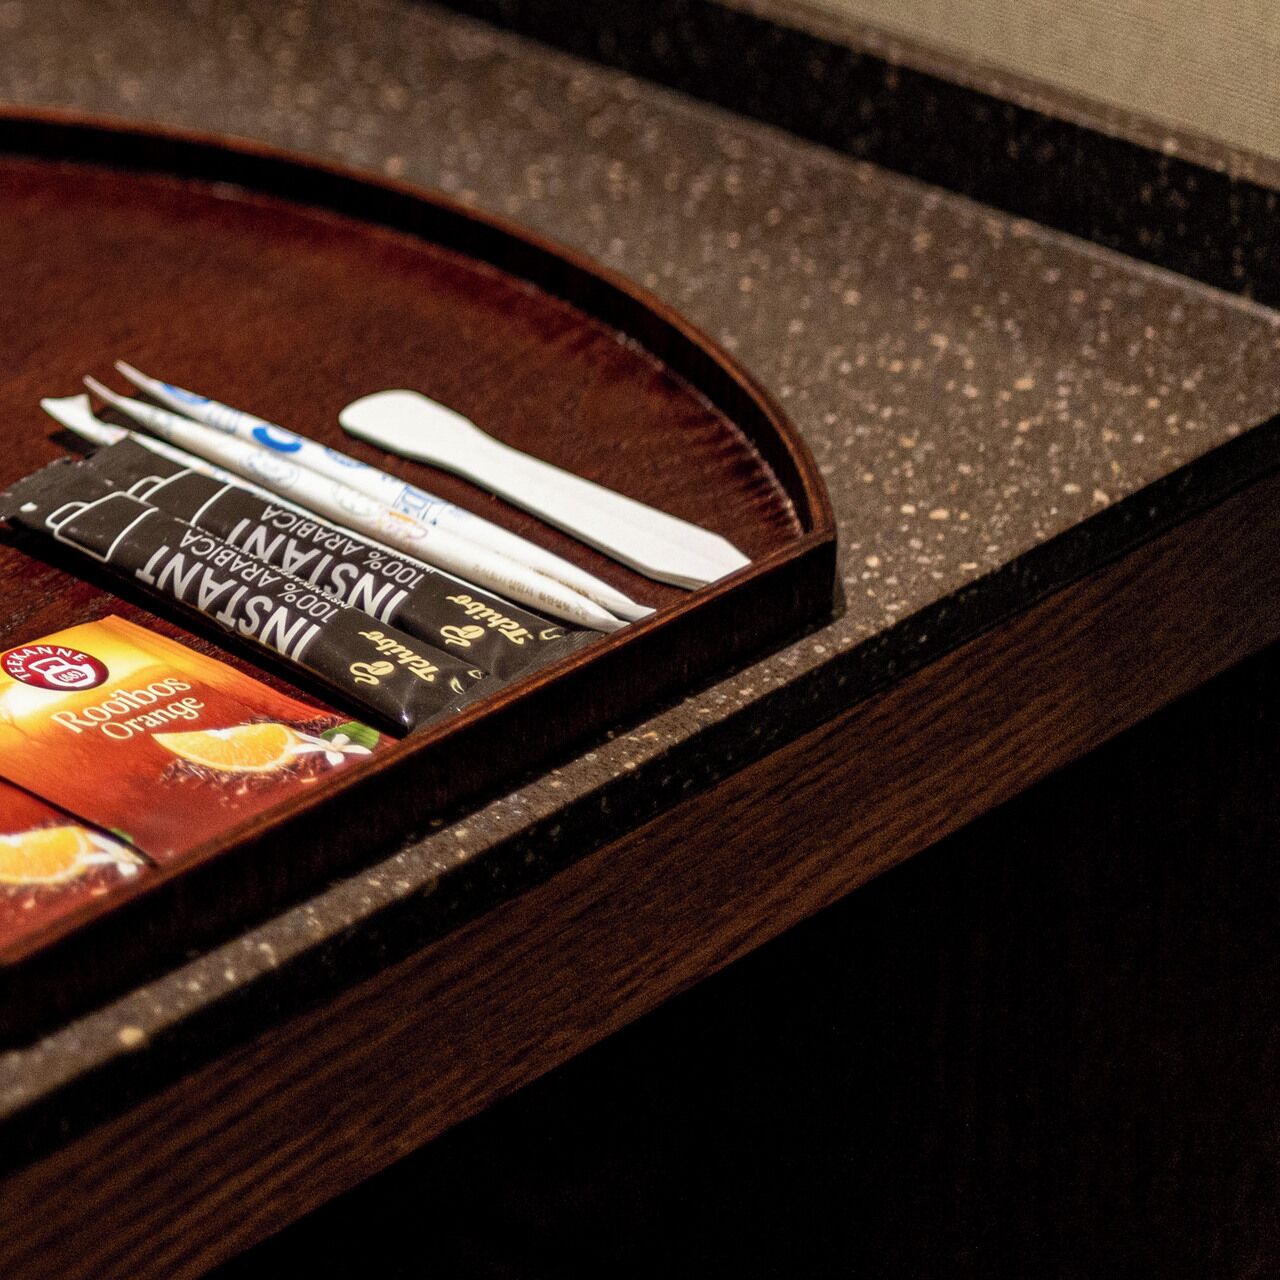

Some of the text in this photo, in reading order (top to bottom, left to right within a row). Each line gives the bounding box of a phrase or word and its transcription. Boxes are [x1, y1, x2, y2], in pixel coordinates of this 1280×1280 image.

[260, 505, 366, 557] ARABICA
[179, 528, 283, 588] ARABICA
[362, 545, 427, 590] 100%
[134, 545, 322, 662] INSTANT
[276, 581, 340, 624] 100%
[445, 593, 534, 646] Tchibo
[6, 645, 89, 681] TEEKANNE
[357, 629, 440, 683] Tchibo
[50, 676, 192, 734] Rooibos
[100, 696, 206, 740] Orange
